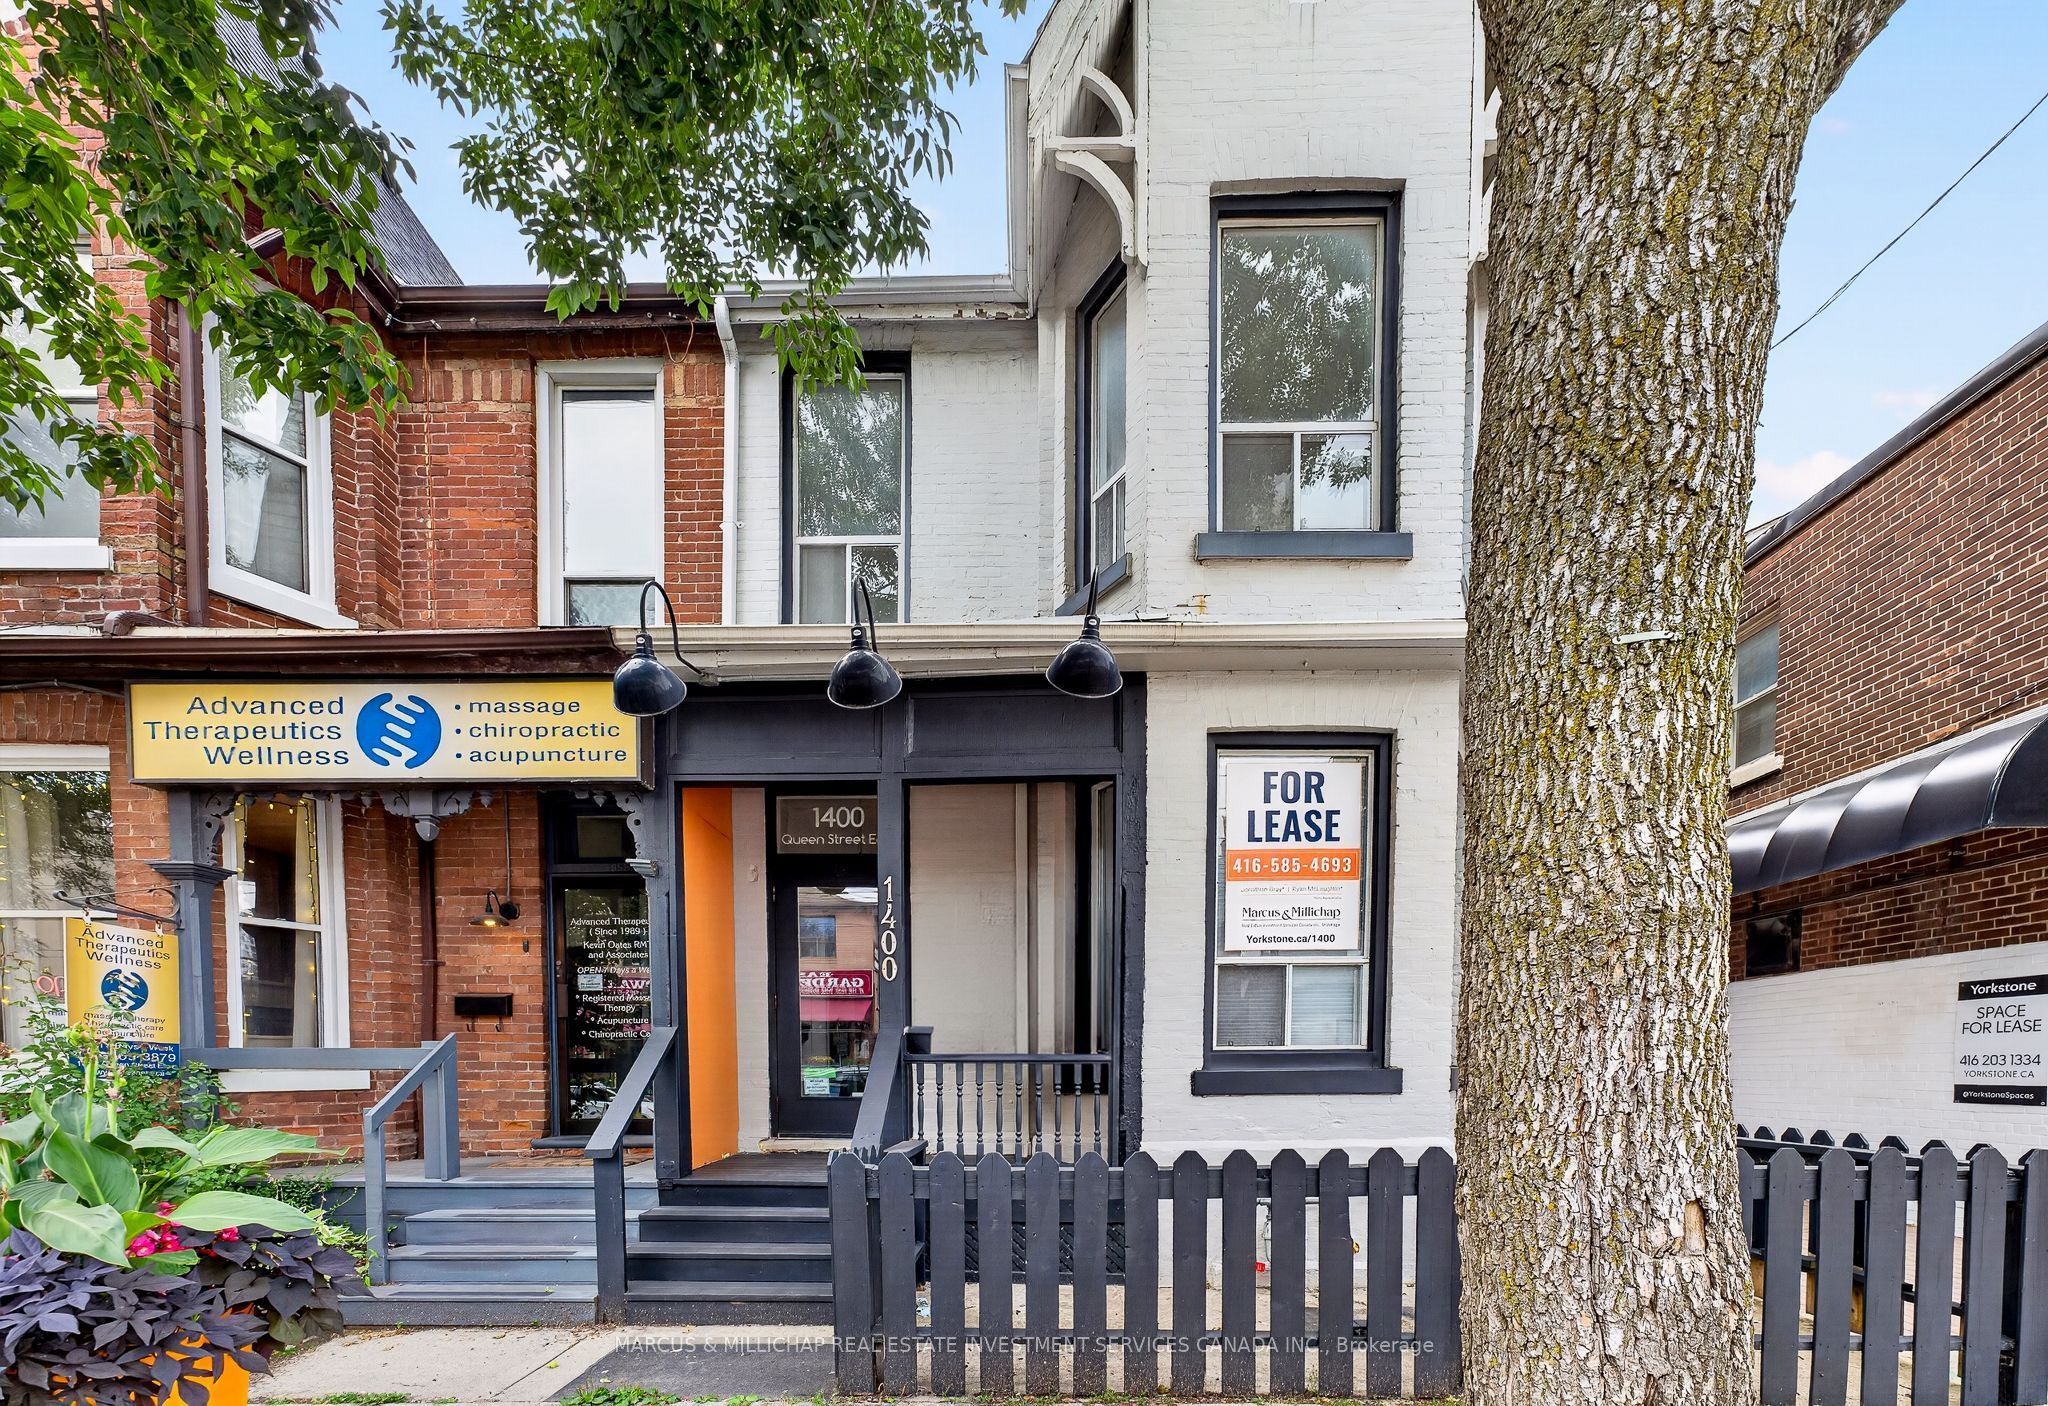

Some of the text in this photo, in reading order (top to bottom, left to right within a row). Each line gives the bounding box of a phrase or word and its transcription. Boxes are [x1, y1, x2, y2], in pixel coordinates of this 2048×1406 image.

[186, 696, 344, 715] Advanced
[469, 700, 580, 716] massage
[143, 721, 342, 743] Therapeutics
[469, 723, 620, 740] chiropractic
[203, 746, 349, 765] Wellness
[469, 748, 627, 765] acupuncture
[1263, 771, 1325, 804] FOR
[813, 806, 865, 828] 1400
[1247, 810, 1341, 842] LEASE
[782, 834, 825, 845] Queen
[828, 833, 866, 845] Street
[1233, 857, 1352, 874] 416-585-4693
[1242, 906, 1341, 921] Marcus & Millichap
[570, 917, 611, 926] Advanced
[880, 875, 898, 982] 1400
[82, 926, 164, 949] Advanced
[594, 927, 618, 936] Since
[621, 927, 640, 935] 1989
[1246, 934, 1336, 944] Yorkstone.ca/1400
[75, 937, 171, 960] Therapeutics
[583, 941, 606, 949] Kevin
[86, 950, 162, 970] Wellness
[606, 951, 649, 959] Associates
[577, 966, 601, 974] OPEN
[610, 966, 630, 975] Days
[1970, 982, 2037, 995] Yorkstone
[582, 994, 625, 1003] Registered
[604, 1004, 636, 1013] Therapy
[1976, 1004, 2027, 1019] SPACE
[597, 1017, 649, 1025] Acupuncture
[1962, 1018, 2043, 1035] FOR LEASE
[588, 1030, 638, 1039] Chiropractic
[1959, 1053, 2042, 1066] 416 203 1334
[1963, 1070, 2035, 1079] YORKSTONE.CA
[1962, 1090, 2035, 1100] @YorkstoneSpaces
